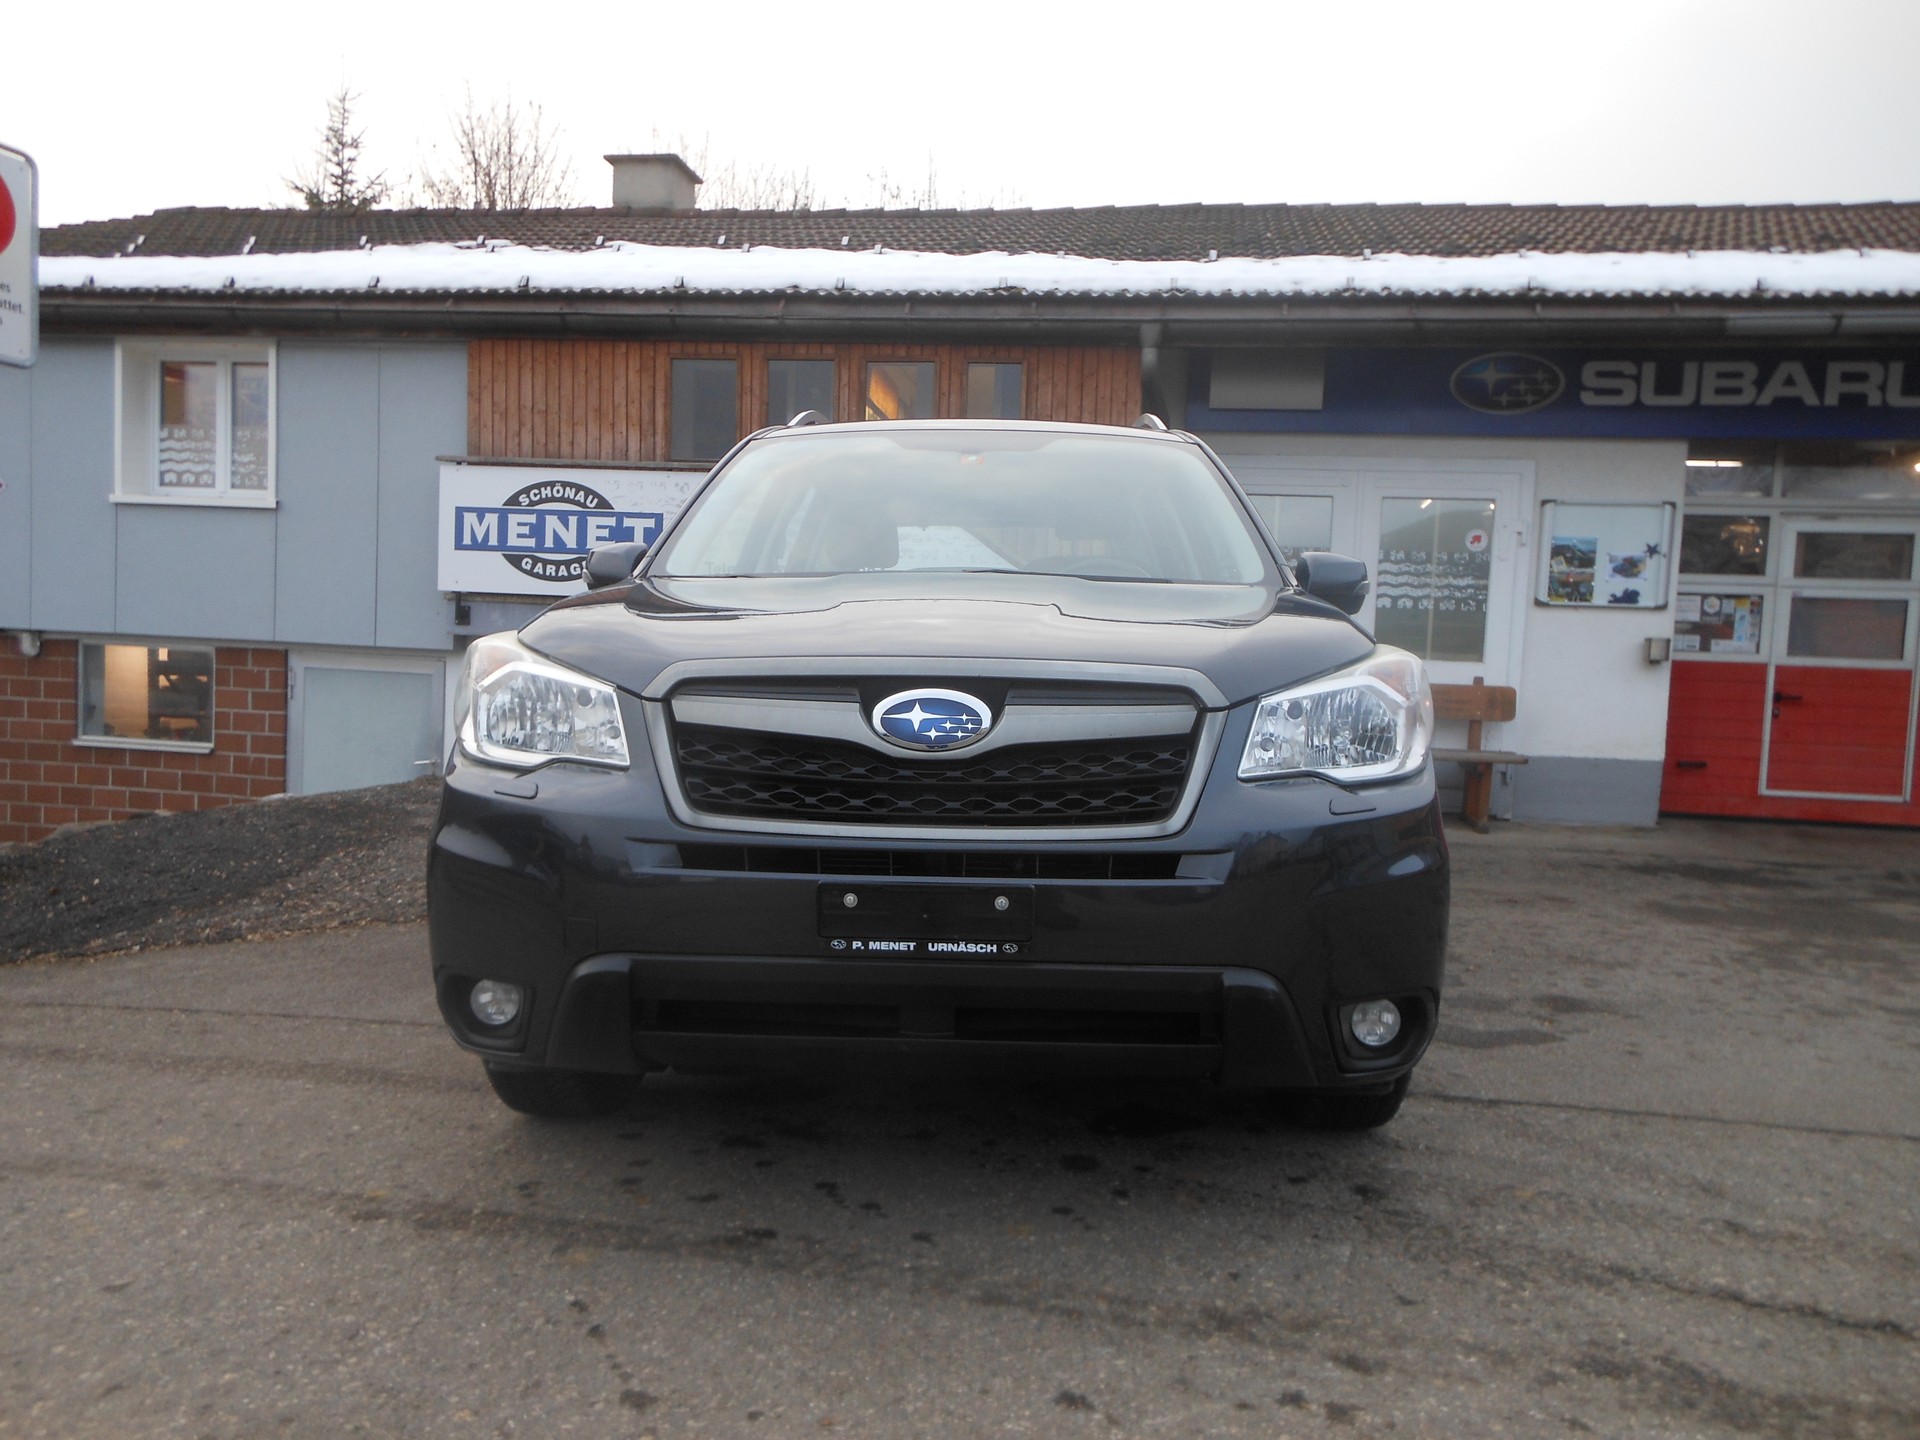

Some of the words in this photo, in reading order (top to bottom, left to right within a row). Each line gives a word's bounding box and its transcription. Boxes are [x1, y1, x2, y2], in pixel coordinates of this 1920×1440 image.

[518, 482, 599, 509] SCHÖNAU
[462, 511, 656, 549] MENET
[521, 556, 587, 578] GARAG
[852, 941, 865, 950] P.
[868, 941, 917, 951] MENET
[928, 941, 998, 953] URNÄSCH
